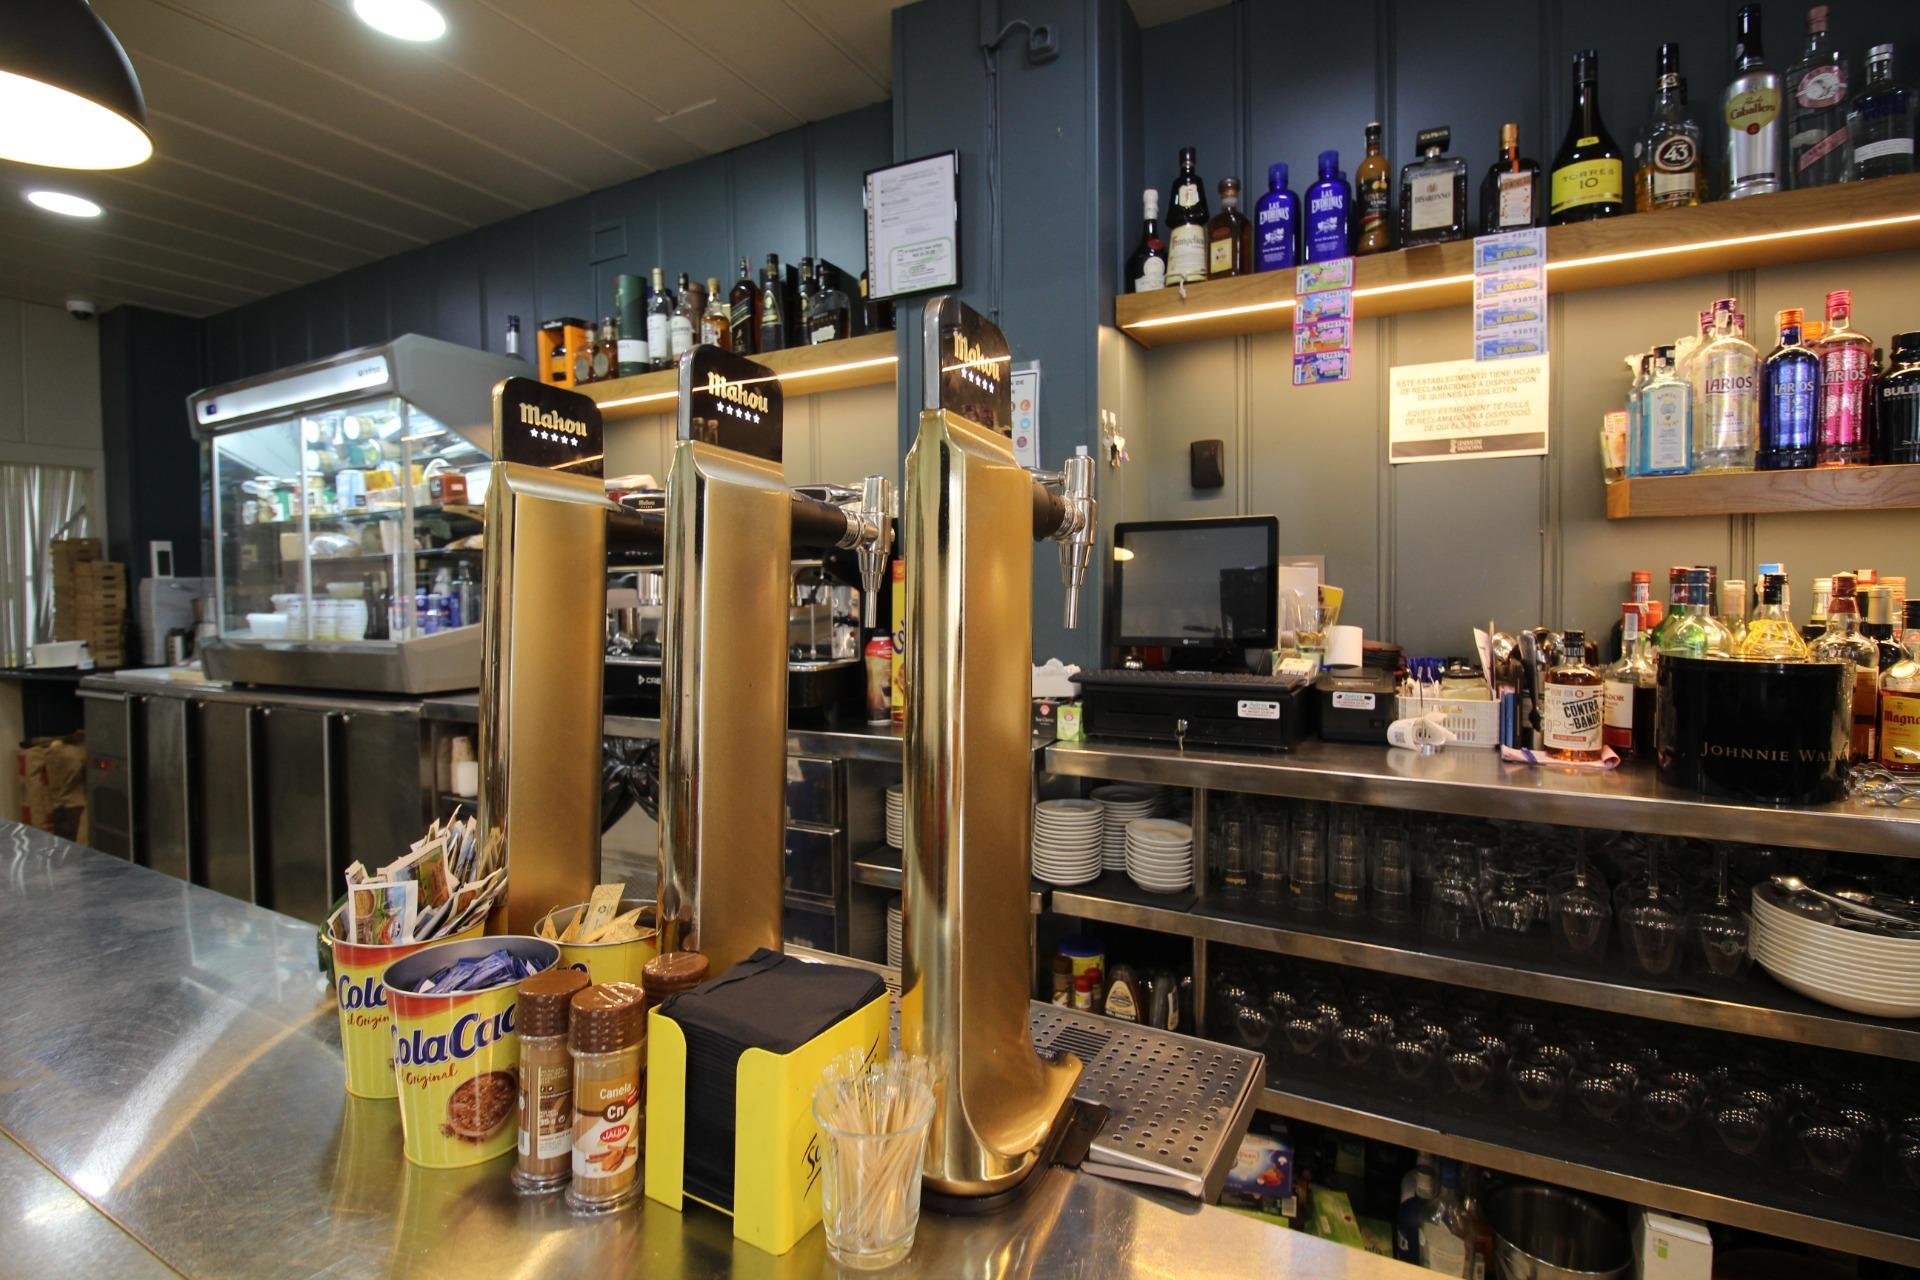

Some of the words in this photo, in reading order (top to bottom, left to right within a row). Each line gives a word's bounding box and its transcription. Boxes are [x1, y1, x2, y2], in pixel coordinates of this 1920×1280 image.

[1663, 144, 1689, 162] 43
[1562, 168, 1615, 182] TORRES
[1579, 177, 1599, 190] 10
[953, 330, 1001, 382] Mahou
[1705, 376, 1753, 394] LARIOS
[1821, 370, 1866, 385] LARIOS
[707, 371, 769, 413] Mahou
[1774, 381, 1815, 396] LARIOS
[519, 402, 588, 437] Mahou
[1563, 699, 1599, 718] CONTRA
[1700, 741, 1790, 762] JOHNNIE
[599, 1083, 632, 1100] Canela
[607, 1105, 625, 1120] Cn
